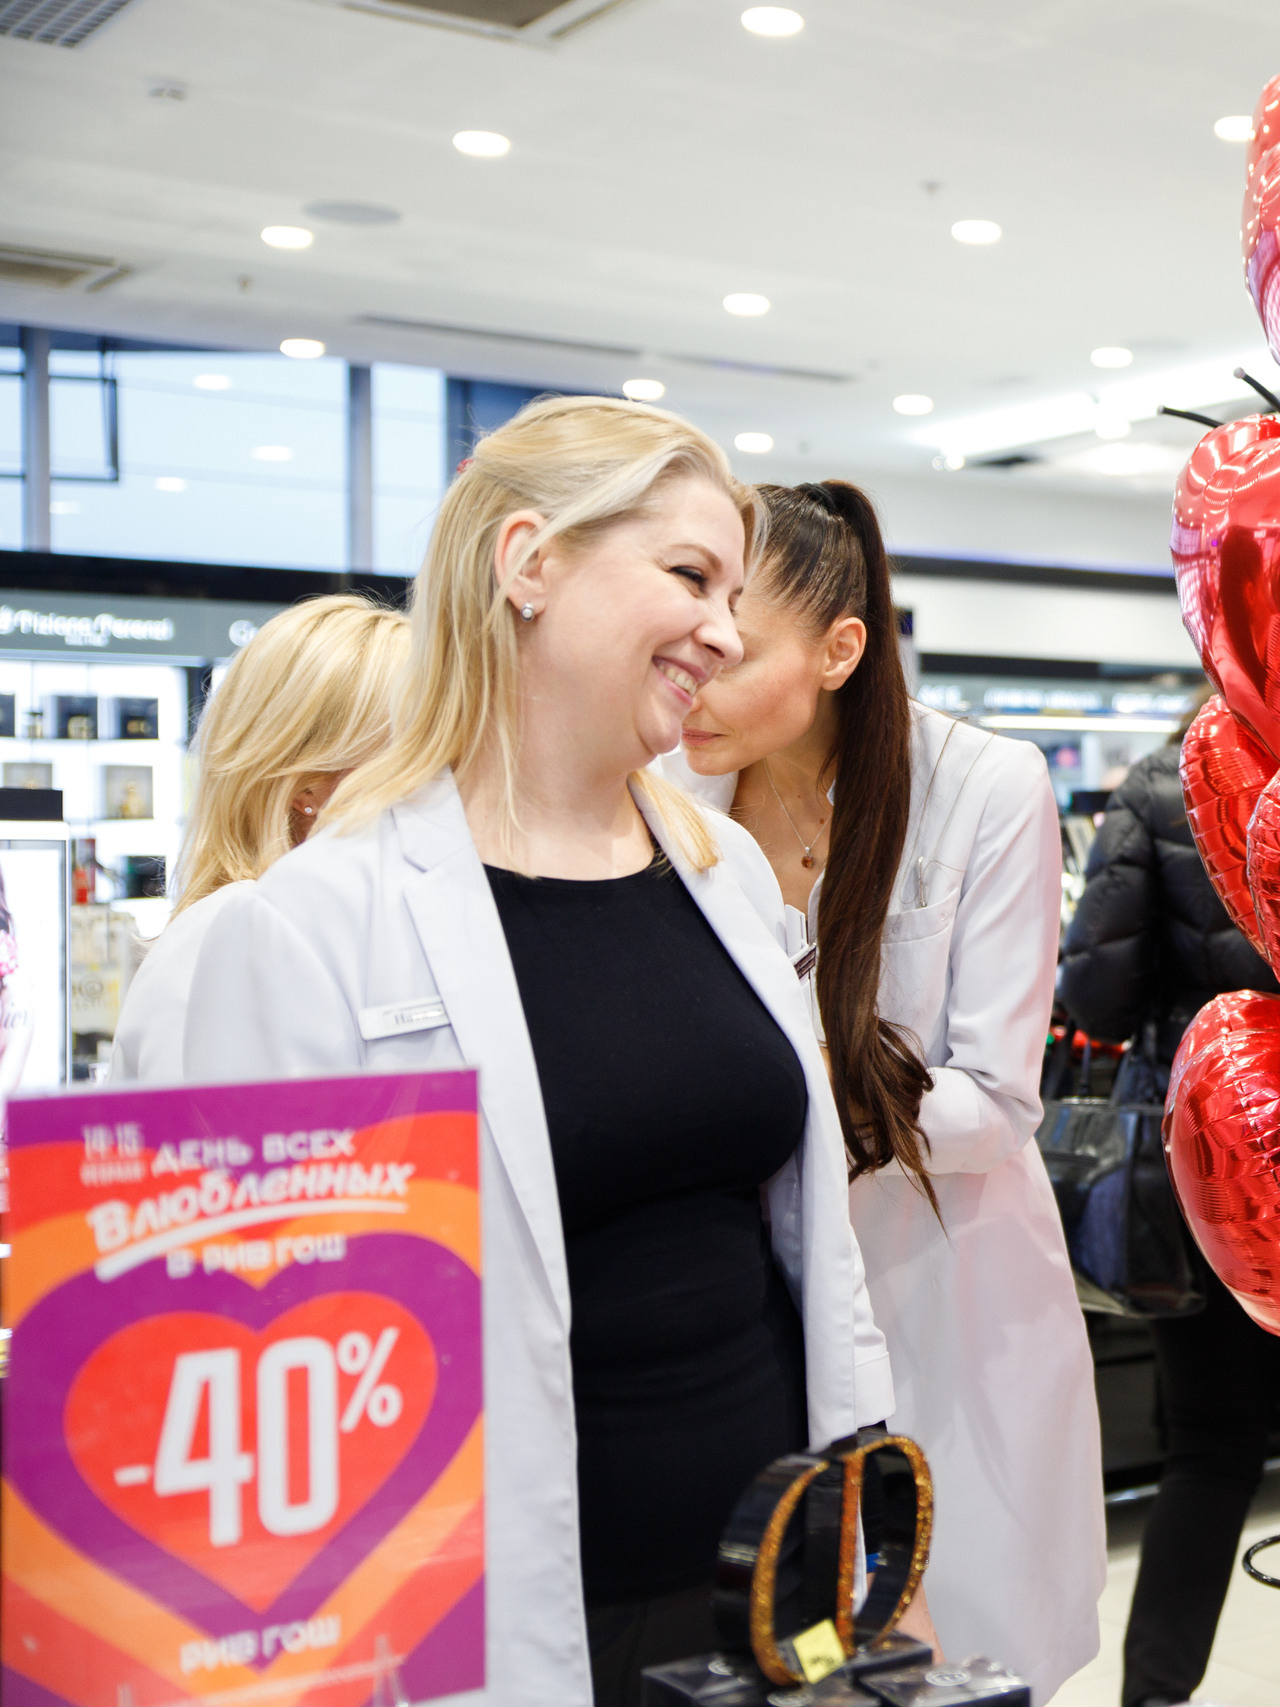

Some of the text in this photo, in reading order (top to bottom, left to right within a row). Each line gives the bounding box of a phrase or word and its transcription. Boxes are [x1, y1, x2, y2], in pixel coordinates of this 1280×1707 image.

[153, 1140, 252, 1177] ДЕНЬ
[262, 1128, 355, 1163] ВСЕХ
[166, 1233, 347, 1280] В РИВ ГОШ
[114, 1326, 402, 1548] -40%
[180, 1614, 341, 1674] РИВ ГОШ
